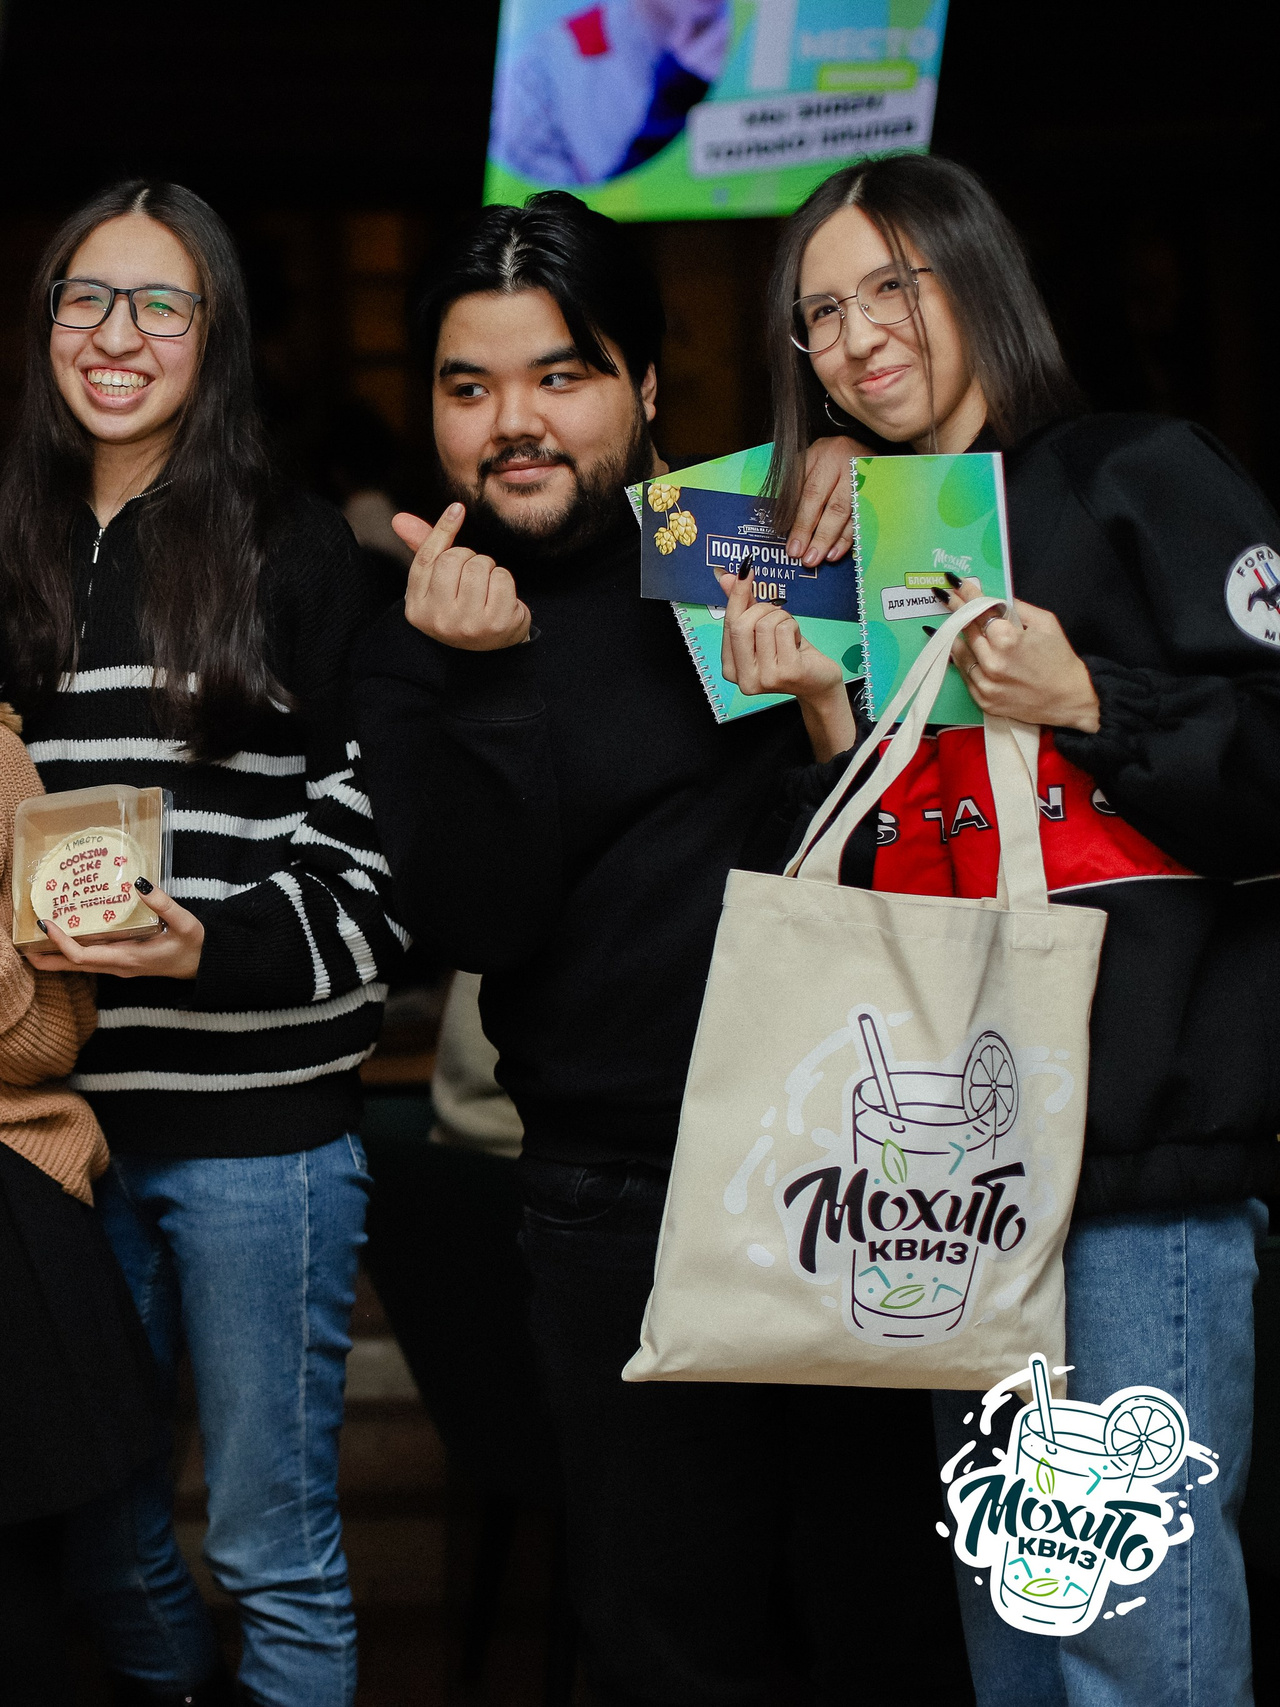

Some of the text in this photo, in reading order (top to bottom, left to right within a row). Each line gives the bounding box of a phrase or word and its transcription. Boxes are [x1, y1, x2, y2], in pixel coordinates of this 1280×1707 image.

[711, 539, 803, 567] ПОДАРОЧНЫ
[728, 562, 796, 580] СЕИФИКАТ
[907, 576, 946, 586] БЛОКНО
[888, 599, 905, 610] ДЛЯ
[906, 595, 937, 607] УМНЫХ
[1264, 629, 1280, 642] M
[59, 847, 109, 871] COOKING
[72, 859, 102, 876] LIKE
[62, 872, 99, 893] A CHEF
[72, 890, 80, 898] A
[783, 1161, 1027, 1274] Мохито
[868, 1238, 969, 1265] КВИЗ
